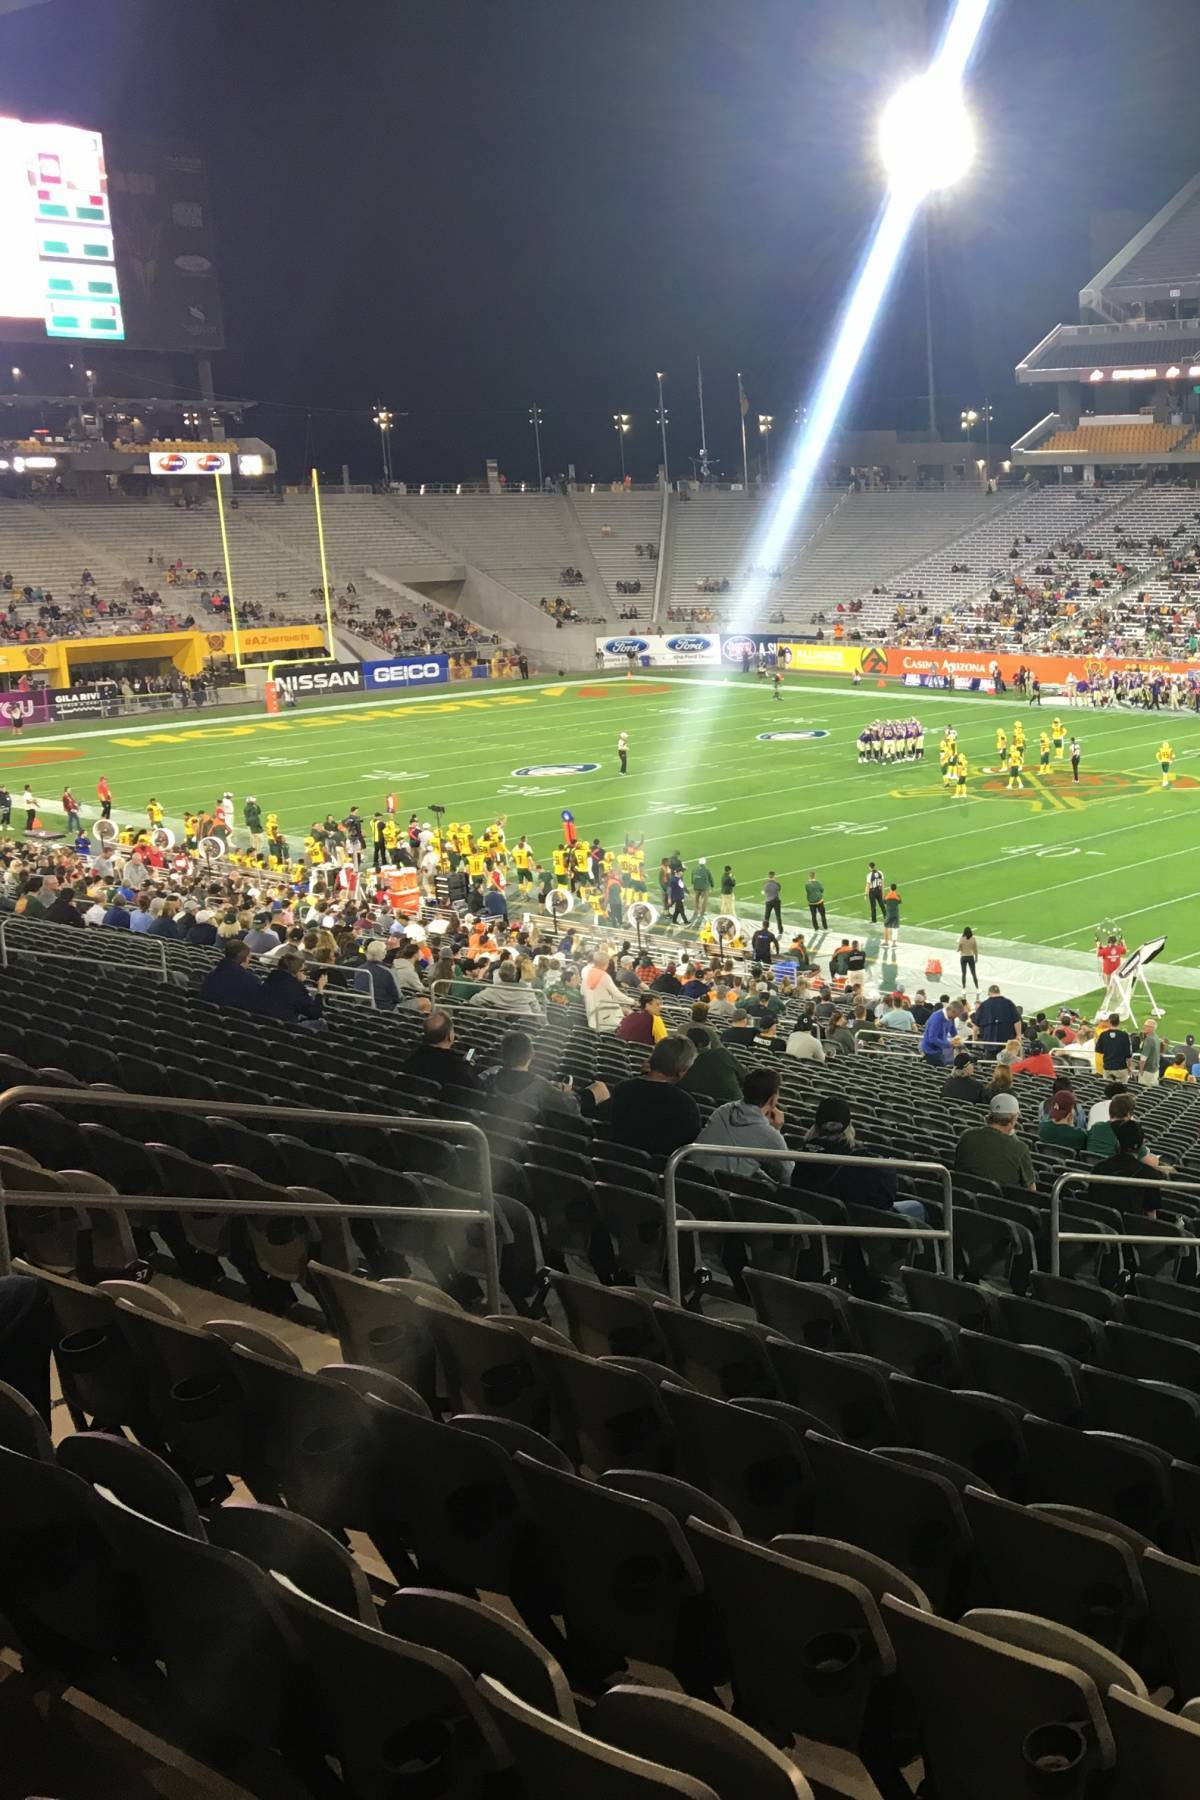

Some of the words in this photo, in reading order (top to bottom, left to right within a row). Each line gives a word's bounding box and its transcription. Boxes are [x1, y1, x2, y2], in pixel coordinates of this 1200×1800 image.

[612, 640, 640, 653] Ford
[675, 637, 704, 651] Ford
[373, 662, 440, 683] GEICO
[275, 670, 360, 692] NISSAN
[55, 693, 79, 703] GILA
[109, 694, 534, 748] HOTSHOTS
[810, 820, 889, 836] 50
[136, 1269, 148, 1281] 37
